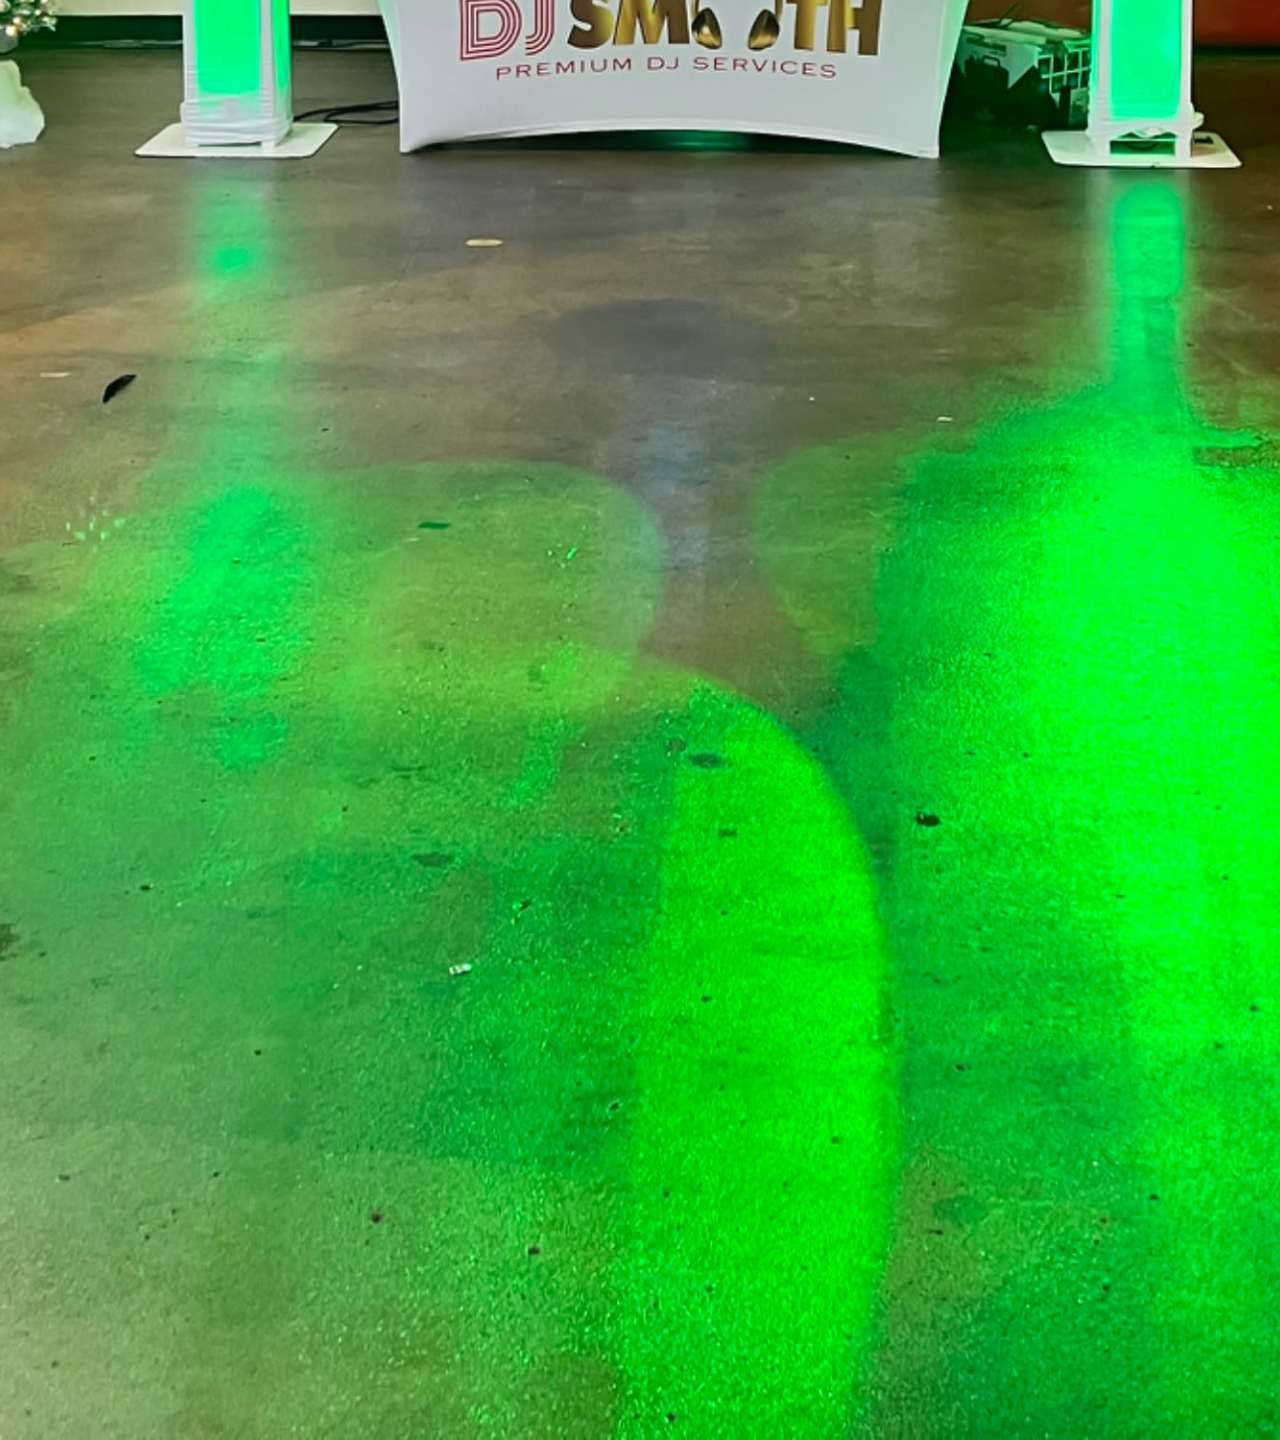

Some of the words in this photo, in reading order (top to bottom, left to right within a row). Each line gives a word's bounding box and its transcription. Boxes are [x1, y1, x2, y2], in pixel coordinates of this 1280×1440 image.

[495, 57, 632, 81] PREMIUM
[647, 56, 680, 71] DJ
[692, 56, 838, 79] SERVICES
